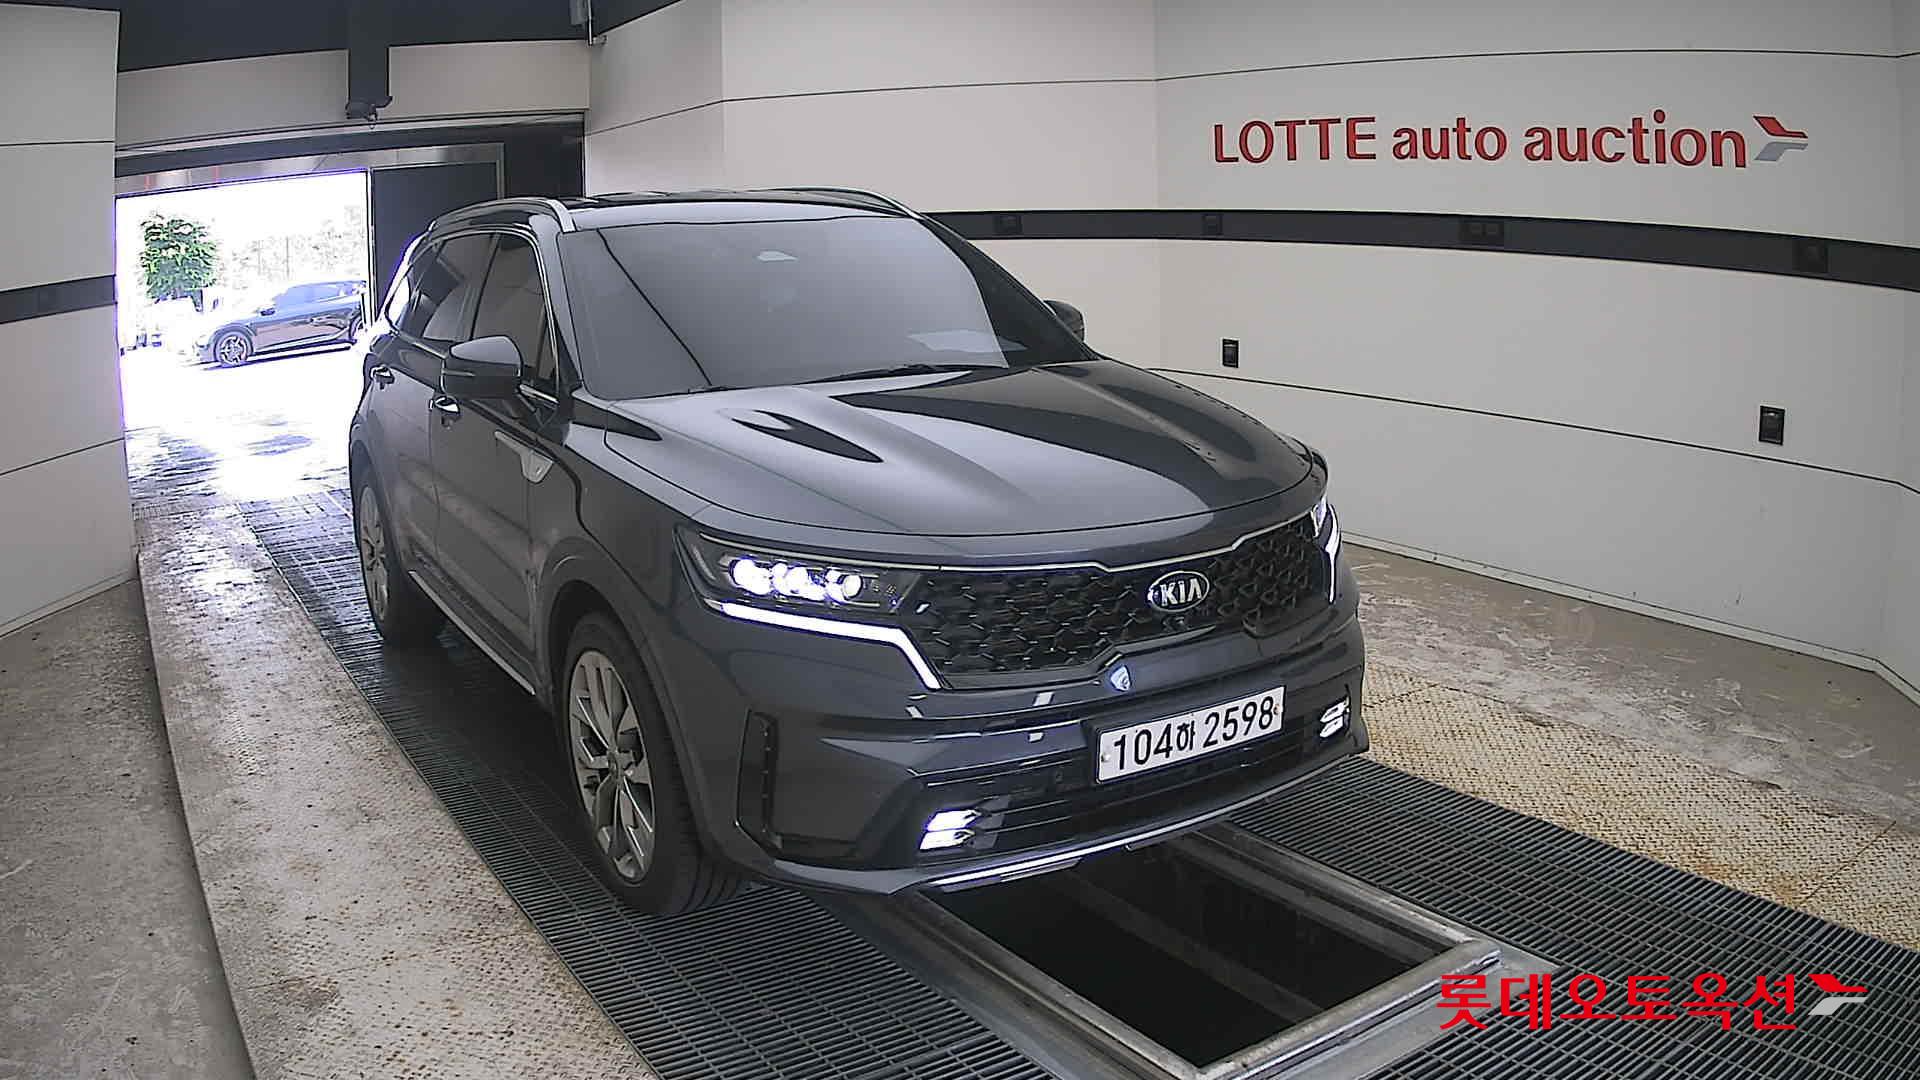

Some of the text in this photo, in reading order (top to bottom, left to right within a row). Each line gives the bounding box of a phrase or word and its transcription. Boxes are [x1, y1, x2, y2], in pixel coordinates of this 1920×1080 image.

[1214, 109, 1747, 168] LOTTE auto auction
[1160, 578, 1202, 606] KIA
[1114, 697, 1274, 770] 104하 2598
